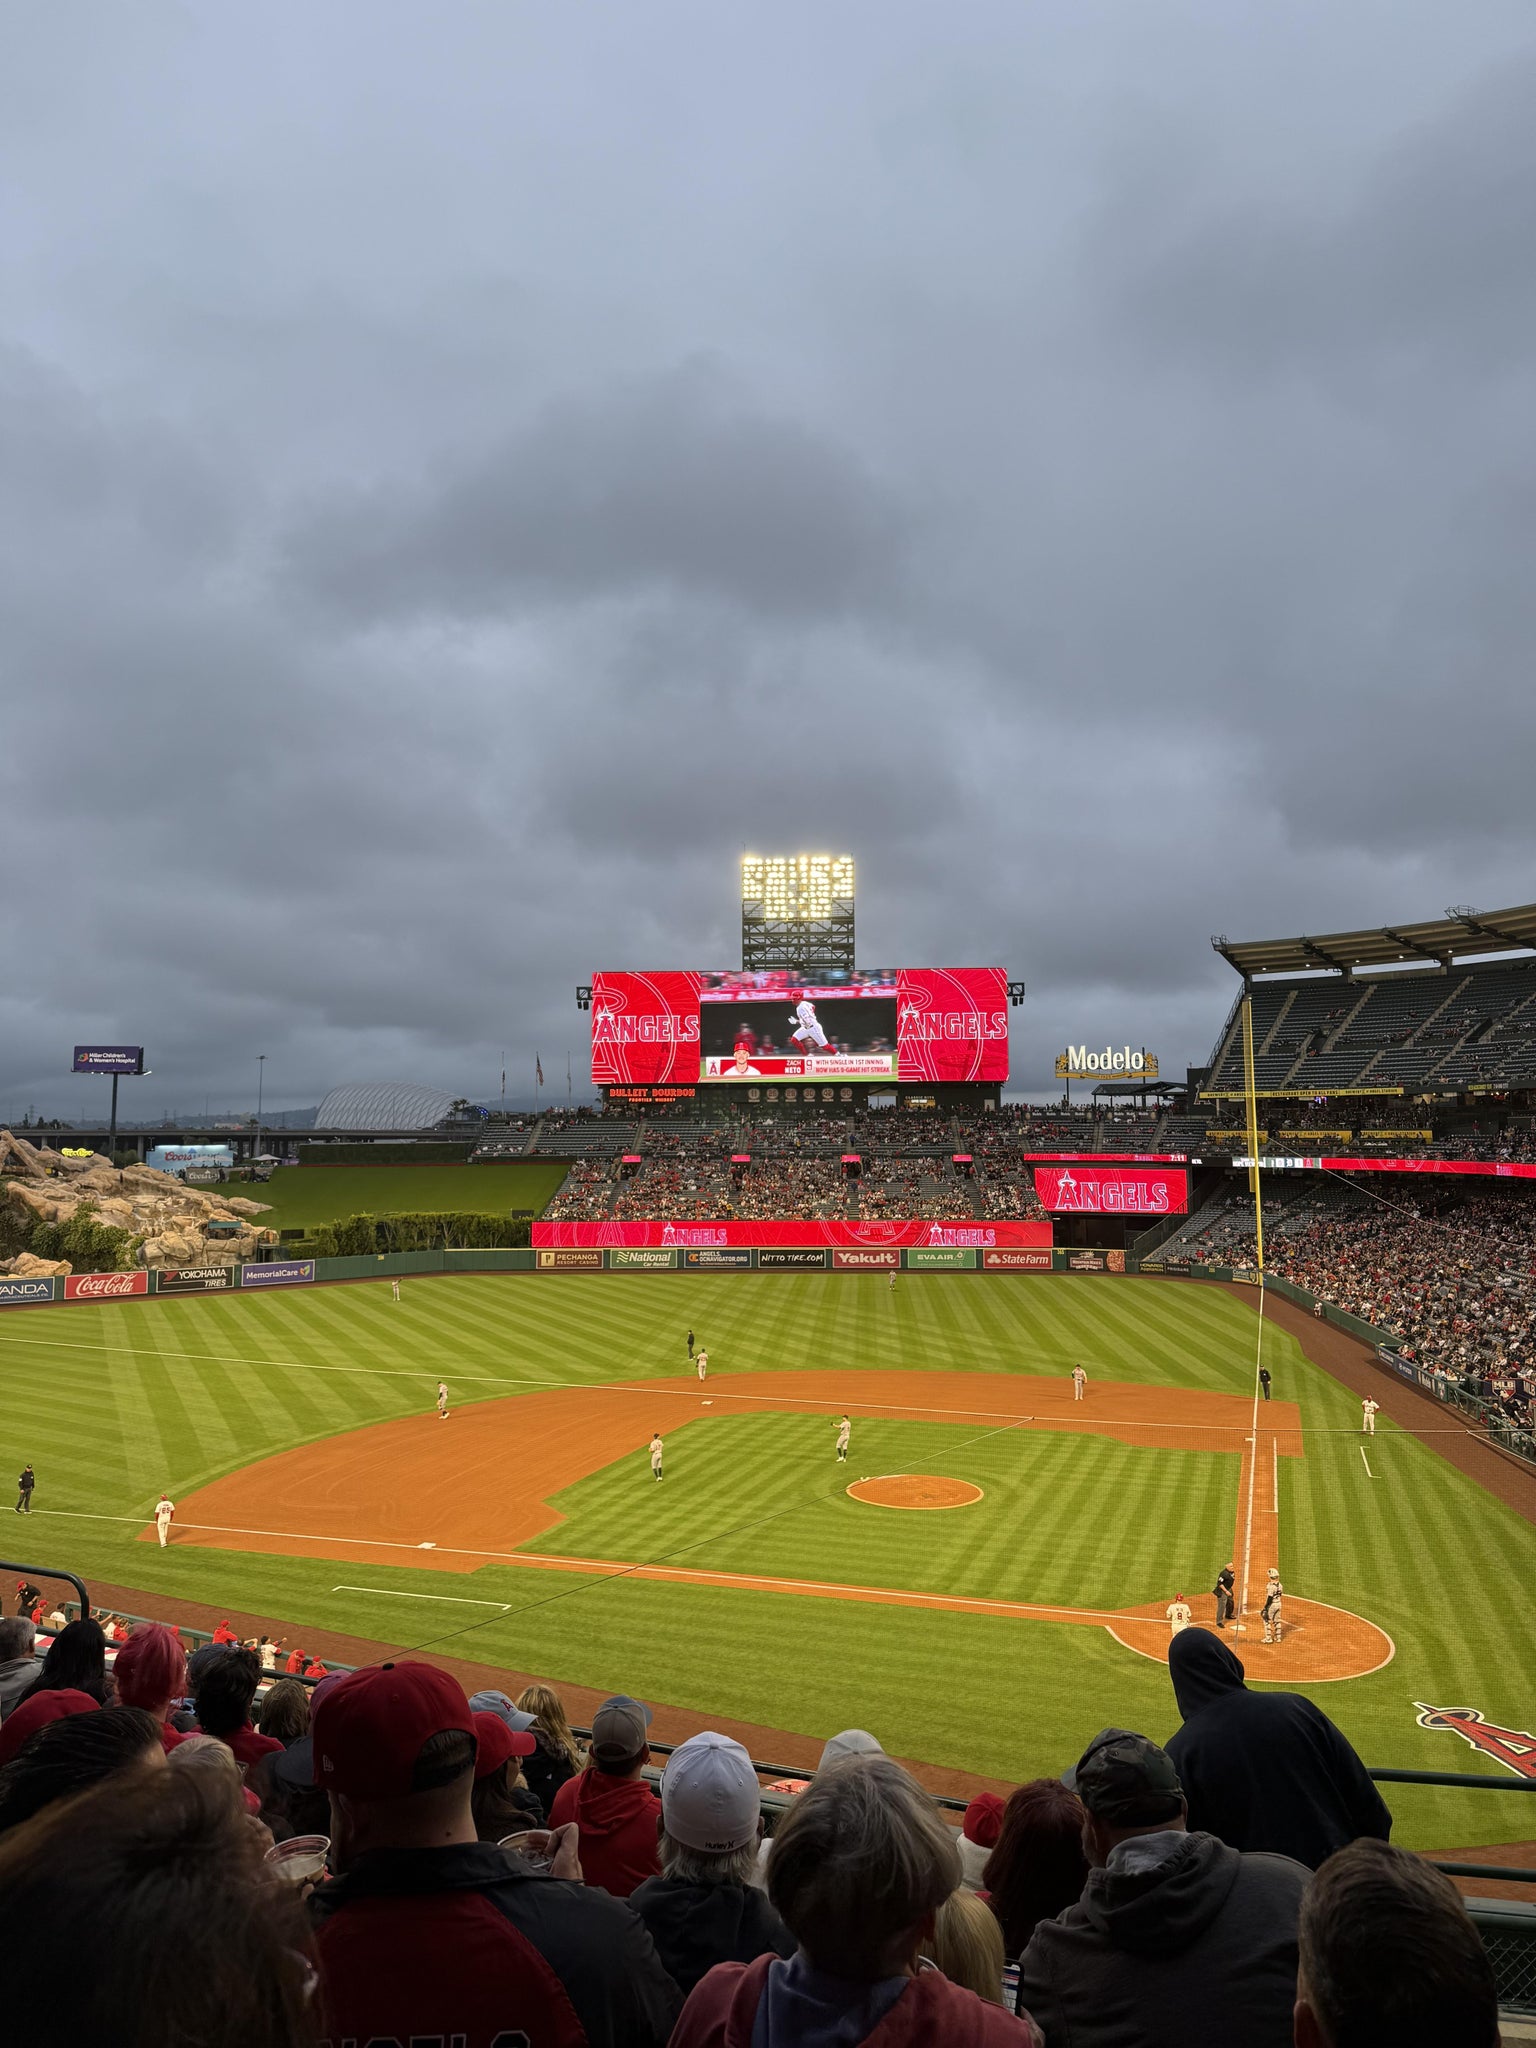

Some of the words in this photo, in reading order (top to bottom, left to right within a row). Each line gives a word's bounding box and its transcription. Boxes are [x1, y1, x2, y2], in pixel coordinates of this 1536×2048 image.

[592, 1004, 700, 1042] ANGELS
[898, 1001, 1008, 1040] ANGELS
[1067, 1045, 1144, 1071] Modelo
[652, 1088, 696, 1097] BOURBON
[165, 1151, 192, 1161] Coors
[1055, 1169, 1169, 1211] ANGELS
[661, 1221, 728, 1247] ANGELS
[928, 1221, 996, 1247] ANGELS
[628, 1252, 672, 1262] National
[761, 1254, 785, 1262] NITTO
[787, 1254, 823, 1262] TIRE.COM
[838, 1253, 897, 1264] Yakult
[178, 1268, 226, 1280] YOKOHAMA
[246, 1269, 298, 1280] MemorialCare
[0, 1283, 49, 1295] ANDA
[76, 1273, 137, 1296] Coca-Cola
[204, 1279, 226, 1288] TIRES
